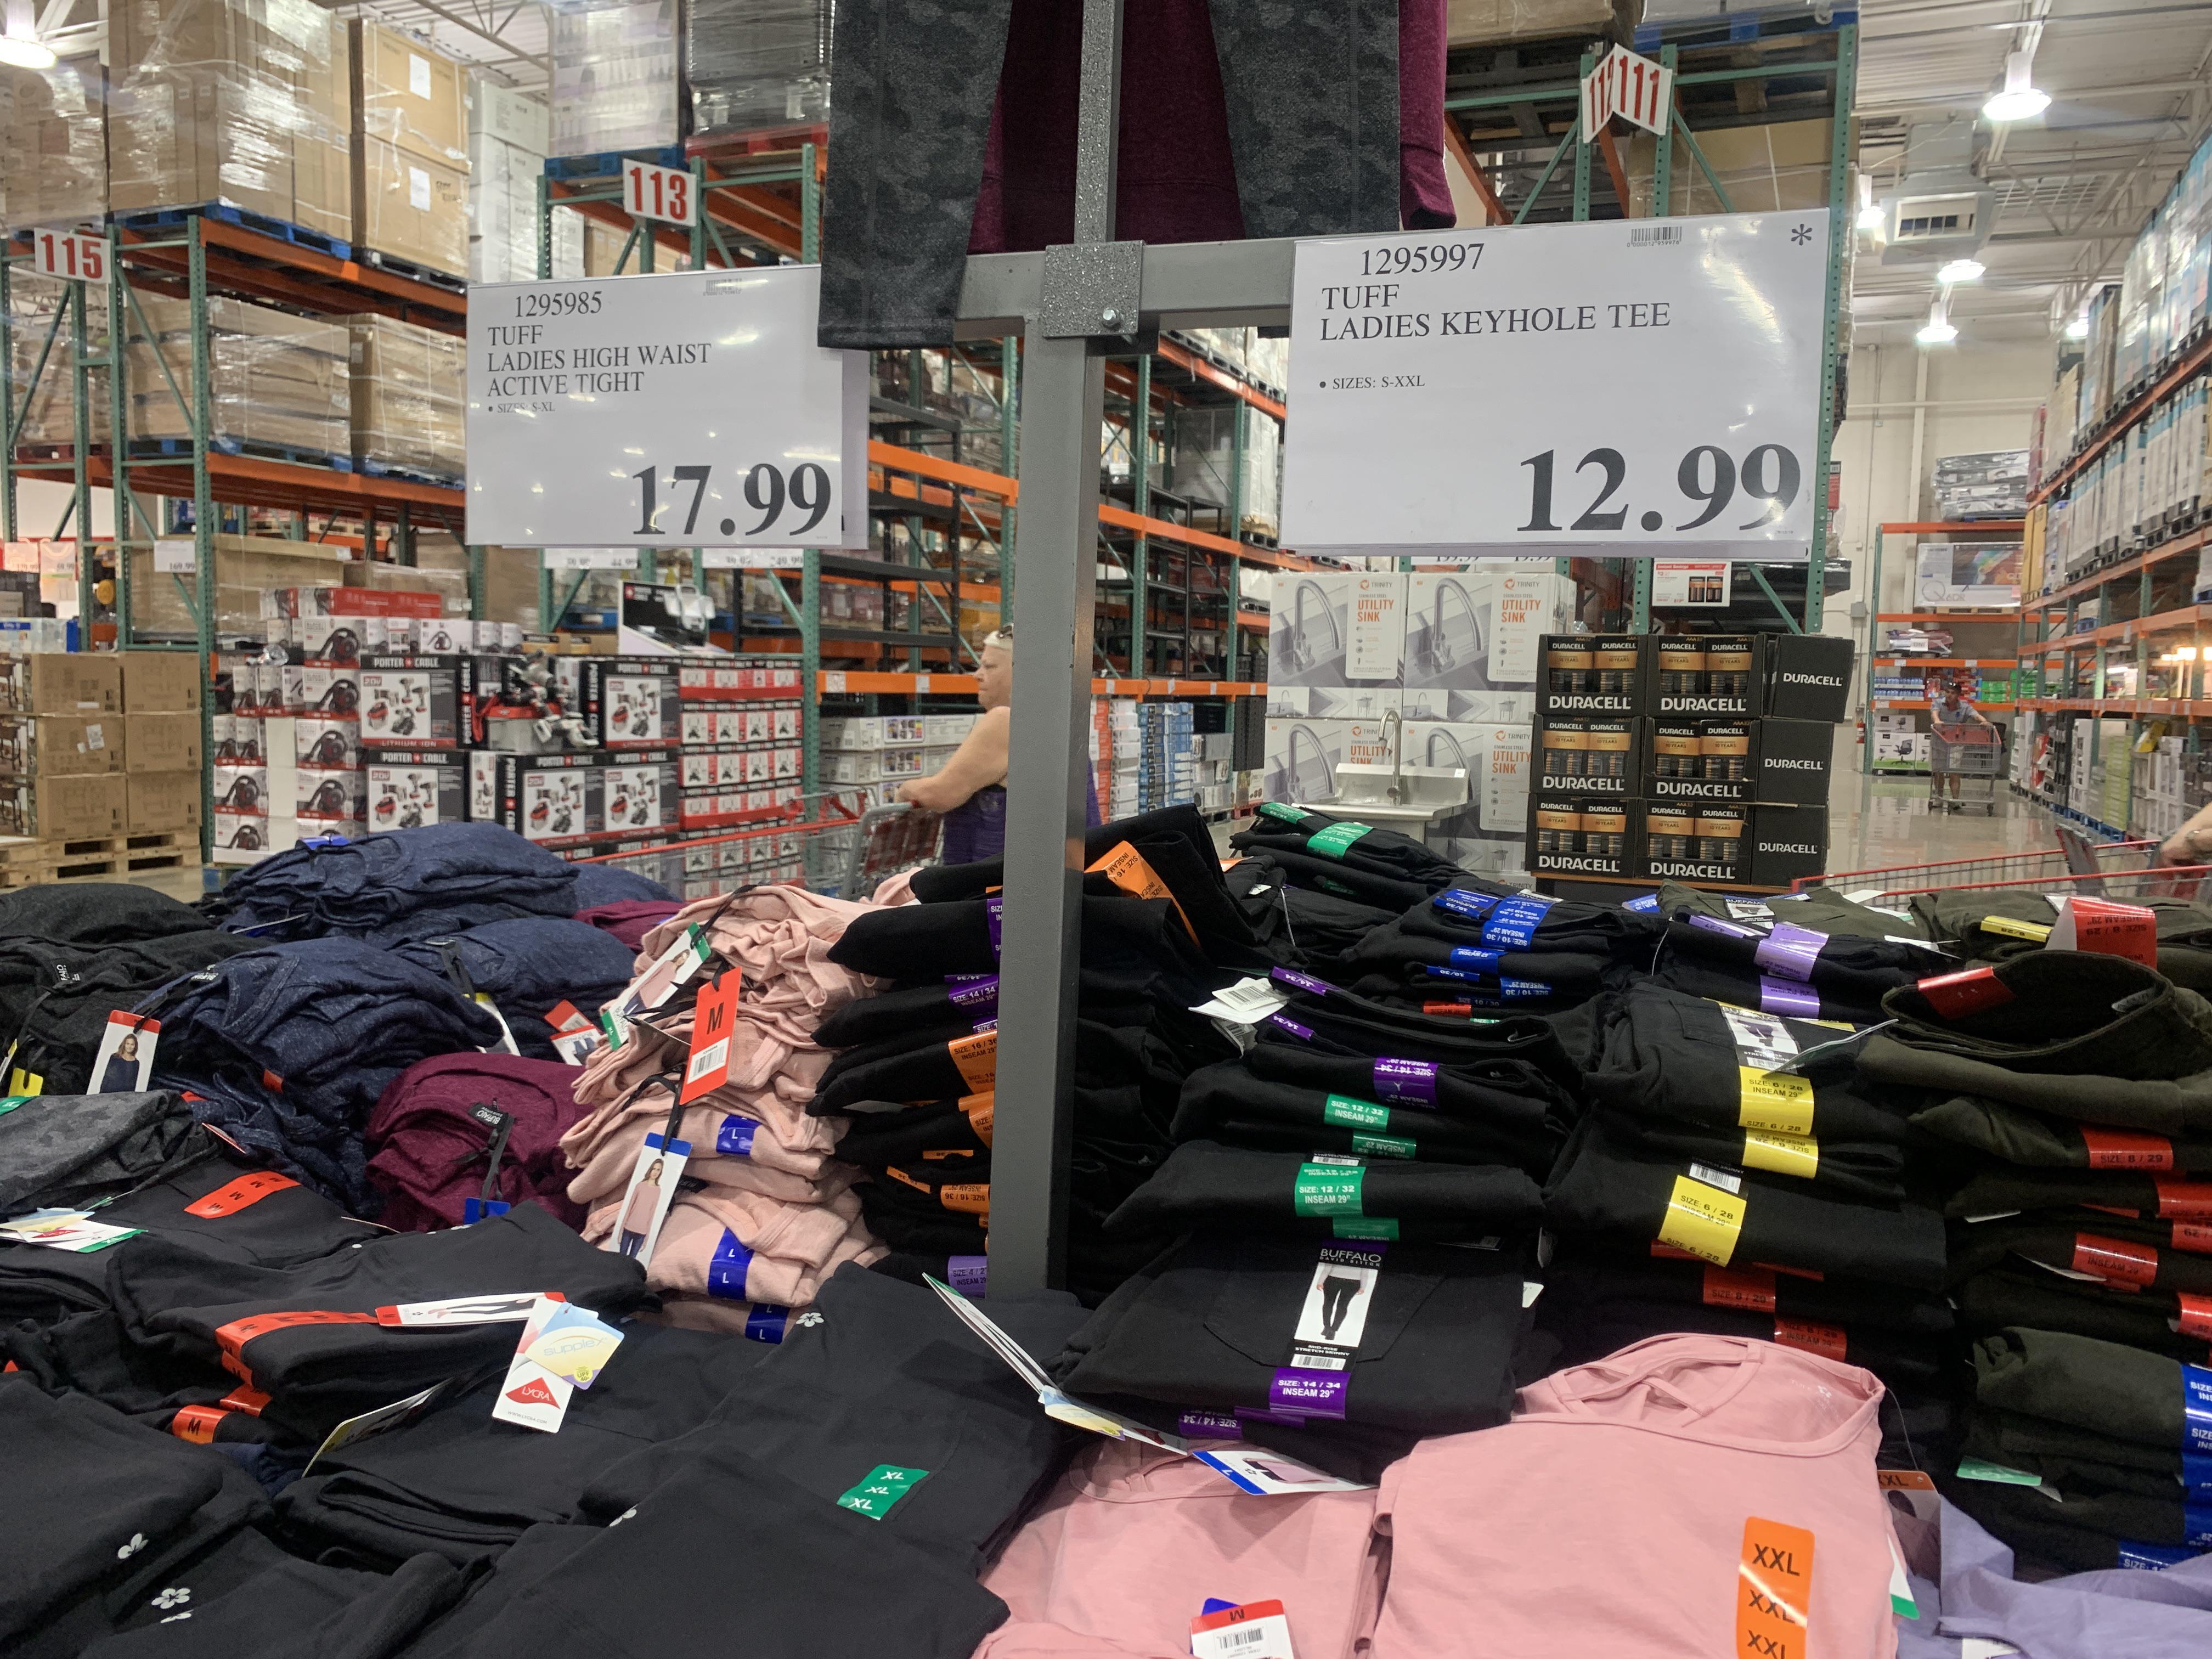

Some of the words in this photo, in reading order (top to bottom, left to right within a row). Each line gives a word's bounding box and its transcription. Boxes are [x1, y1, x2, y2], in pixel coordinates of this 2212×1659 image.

[1619, 55, 1660, 127] 111
[629, 167, 687, 220] 113
[40, 233, 103, 279] 115
[1361, 243, 1484, 275] 1295997
[1322, 284, 1400, 309] TUFF
[515, 291, 602, 318] 1295985
[1320, 314, 1430, 341] LADIES
[1440, 306, 1596, 336] KEYHOLE
[1607, 303, 1671, 328] TEE
[488, 325, 543, 346] TUFF
[488, 350, 565, 372] LADIES
[573, 346, 629, 368] HIGH
[637, 343, 712, 365] WAIST
[488, 374, 568, 397] ACTIVE
[575, 371, 645, 393] TIGHT
[1333, 376, 1376, 390] SIZES:
[1381, 374, 1425, 388] S-XXL
[532, 402, 555, 411] S-XL
[1517, 443, 1801, 532] 12.99
[633, 463, 832, 536] 17.99
[1358, 600, 1394, 610] UTILITY
[1502, 600, 1541, 610] UTILITY
[1357, 612, 1380, 622] SINK
[1502, 612, 1526, 623] SINK
[374, 657, 404, 668] PORTER
[1783, 673, 1843, 687] DURACELL
[1549, 696, 1632, 709] DURACELL
[1661, 698, 1747, 711] DURACELL
[1351, 746, 1386, 757] UTILITY
[1493, 751, 1532, 763] UTILITY
[382, 753, 411, 764] PORTER
[1764, 758, 1824, 770] DURACELL
[1492, 763, 1516, 774] SINK
[1543, 776, 1624, 791] DURACELL
[1657, 782, 1742, 798] DURACELL
[1759, 843, 1818, 855] DURACELL
[1108, 852, 1129, 873] INSEAM
[1125, 856, 1138, 869] SIZE:
[1539, 856, 1620, 872] DURACELL
[1116, 868, 1126, 877] 16
[1650, 862, 1735, 879] DURACELL
[1501, 928, 1525, 938] INSEAM
[1514, 938, 1527, 946] SIZE:
[953, 994, 968, 1003] SIZE:
[969, 990, 980, 998] 14
[986, 986, 996, 995] 34
[706, 1002, 725, 1035] M
[1752, 1087, 1786, 1096] INSEAM
[1331, 1101, 1350, 1109] SIZE:
[1335, 1109, 1364, 1122] INSEAM
[732, 1128, 738, 1139] L
[1305, 1195, 1336, 1204] INSEAM
[1680, 1195, 1702, 1206] SIZE:
[1720, 1210, 1734, 1219] 28
[729, 1248, 736, 1258] L
[1321, 1249, 1381, 1263] BUFFALO
[1667, 1237, 1685, 1249] SIZE:
[1706, 1252, 1719, 1262] 28
[723, 1272, 729, 1284] L
[957, 1278, 978, 1286] INSEAM
[759, 1329, 766, 1340] L
[544, 1339, 605, 1356] supplex
[522, 1386, 550, 1401] LYCRA
[1283, 1388, 1317, 1397] INSEAM
[507, 1410, 548, 1424] WWW.LYCRA.COM
[188, 1417, 202, 1434] M
[881, 1471, 905, 1480] XL
[865, 1486, 889, 1494] XL
[848, 1498, 873, 1510] XL
[1752, 1543, 1800, 1576] XXL
[1230, 1609, 1245, 1621] M
